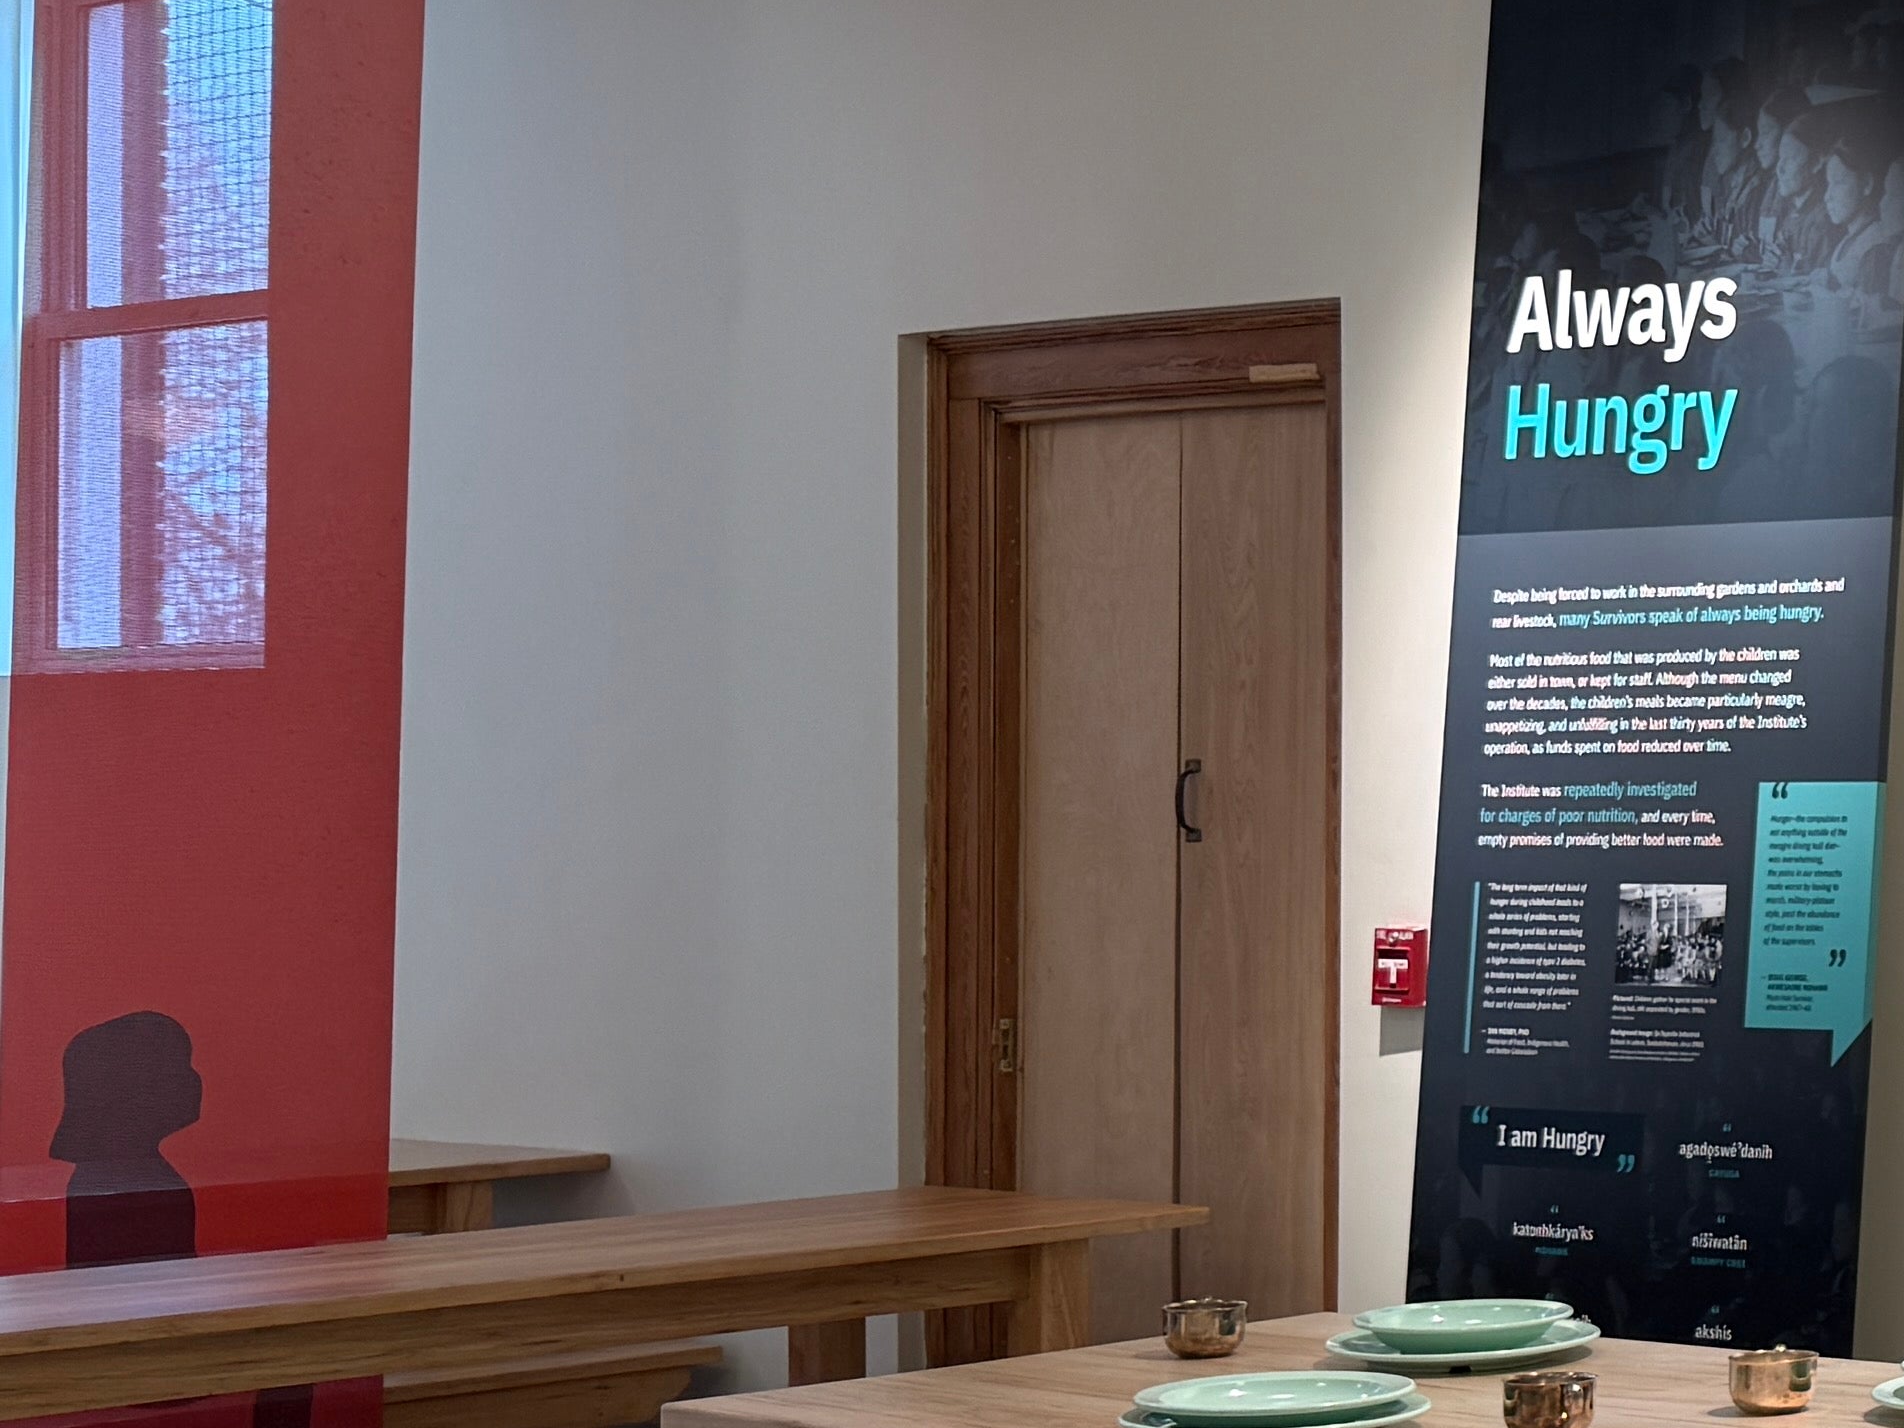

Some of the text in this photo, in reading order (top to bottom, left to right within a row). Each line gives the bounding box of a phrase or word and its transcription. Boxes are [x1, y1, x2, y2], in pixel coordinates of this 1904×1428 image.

[1506, 269, 1738, 362] Always
[1505, 383, 1738, 474] Hungry
[1530, 588, 1557, 604] being
[1590, 588, 1601, 599] to
[1602, 586, 1626, 599] work
[1628, 585, 1638, 598] in
[1639, 584, 1656, 598] the
[1716, 581, 1756, 599] gardens
[1757, 580, 1777, 594] and
[1825, 577, 1844, 592] and
[1492, 618, 1512, 628] rear
[1559, 614, 1590, 629] many
[1593, 609, 1646, 625] Survivors
[1648, 608, 1683, 626] speak
[1686, 607, 1698, 622] of
[1700, 607, 1741, 624] always
[1744, 605, 1777, 623] being
[1780, 604, 1824, 622] hungry.
[1514, 653, 1525, 667] of
[1526, 653, 1542, 666] the
[1590, 651, 1612, 665] food
[1613, 651, 1632, 664] that
[1635, 653, 1654, 663] was
[1656, 649, 1703, 666] produced
[1704, 648, 1717, 665] by
[1719, 648, 1735, 661] the
[1737, 647, 1777, 661] children
[1779, 649, 1799, 660] was
[1488, 676, 1516, 689] either
[1539, 675, 1548, 687] in
[1578, 677, 1588, 687] or
[1590, 674, 1611, 689] kept
[1613, 673, 1628, 686] for
[1656, 671, 1699, 688] Although
[1701, 671, 1717, 684] the
[1719, 673, 1747, 684] menu
[1749, 669, 1792, 686] changed
[1487, 700, 1508, 711] over
[1509, 697, 1525, 710] the
[1571, 696, 1586, 709] the
[1666, 695, 1706, 707] became
[1707, 692, 1763, 709] particularly
[1548, 718, 1567, 731] and
[1620, 717, 1629, 730] in
[1631, 717, 1647, 730] the
[1649, 717, 1667, 730] last
[1670, 716, 1696, 732] thirty
[1698, 719, 1724, 732] years
[1726, 715, 1737, 729] of
[1739, 715, 1755, 728] the
[1532, 743, 1544, 754] as
[1546, 740, 1572, 753] funds
[1574, 741, 1601, 756] spent
[1603, 743, 1615, 753] on
[1617, 740, 1639, 752] food
[1641, 739, 1681, 752] reduced
[1683, 742, 1704, 752] over
[1707, 739, 1731, 752] time.
[1481, 781, 1697, 800] The Institute was repeatedly investigated
[1481, 808, 1715, 826] for charges of poor nutrition, and every time,
[1478, 833, 1723, 849] empty promises of providing better food were made.
[1497, 1124, 1605, 1156] I am Hungry
